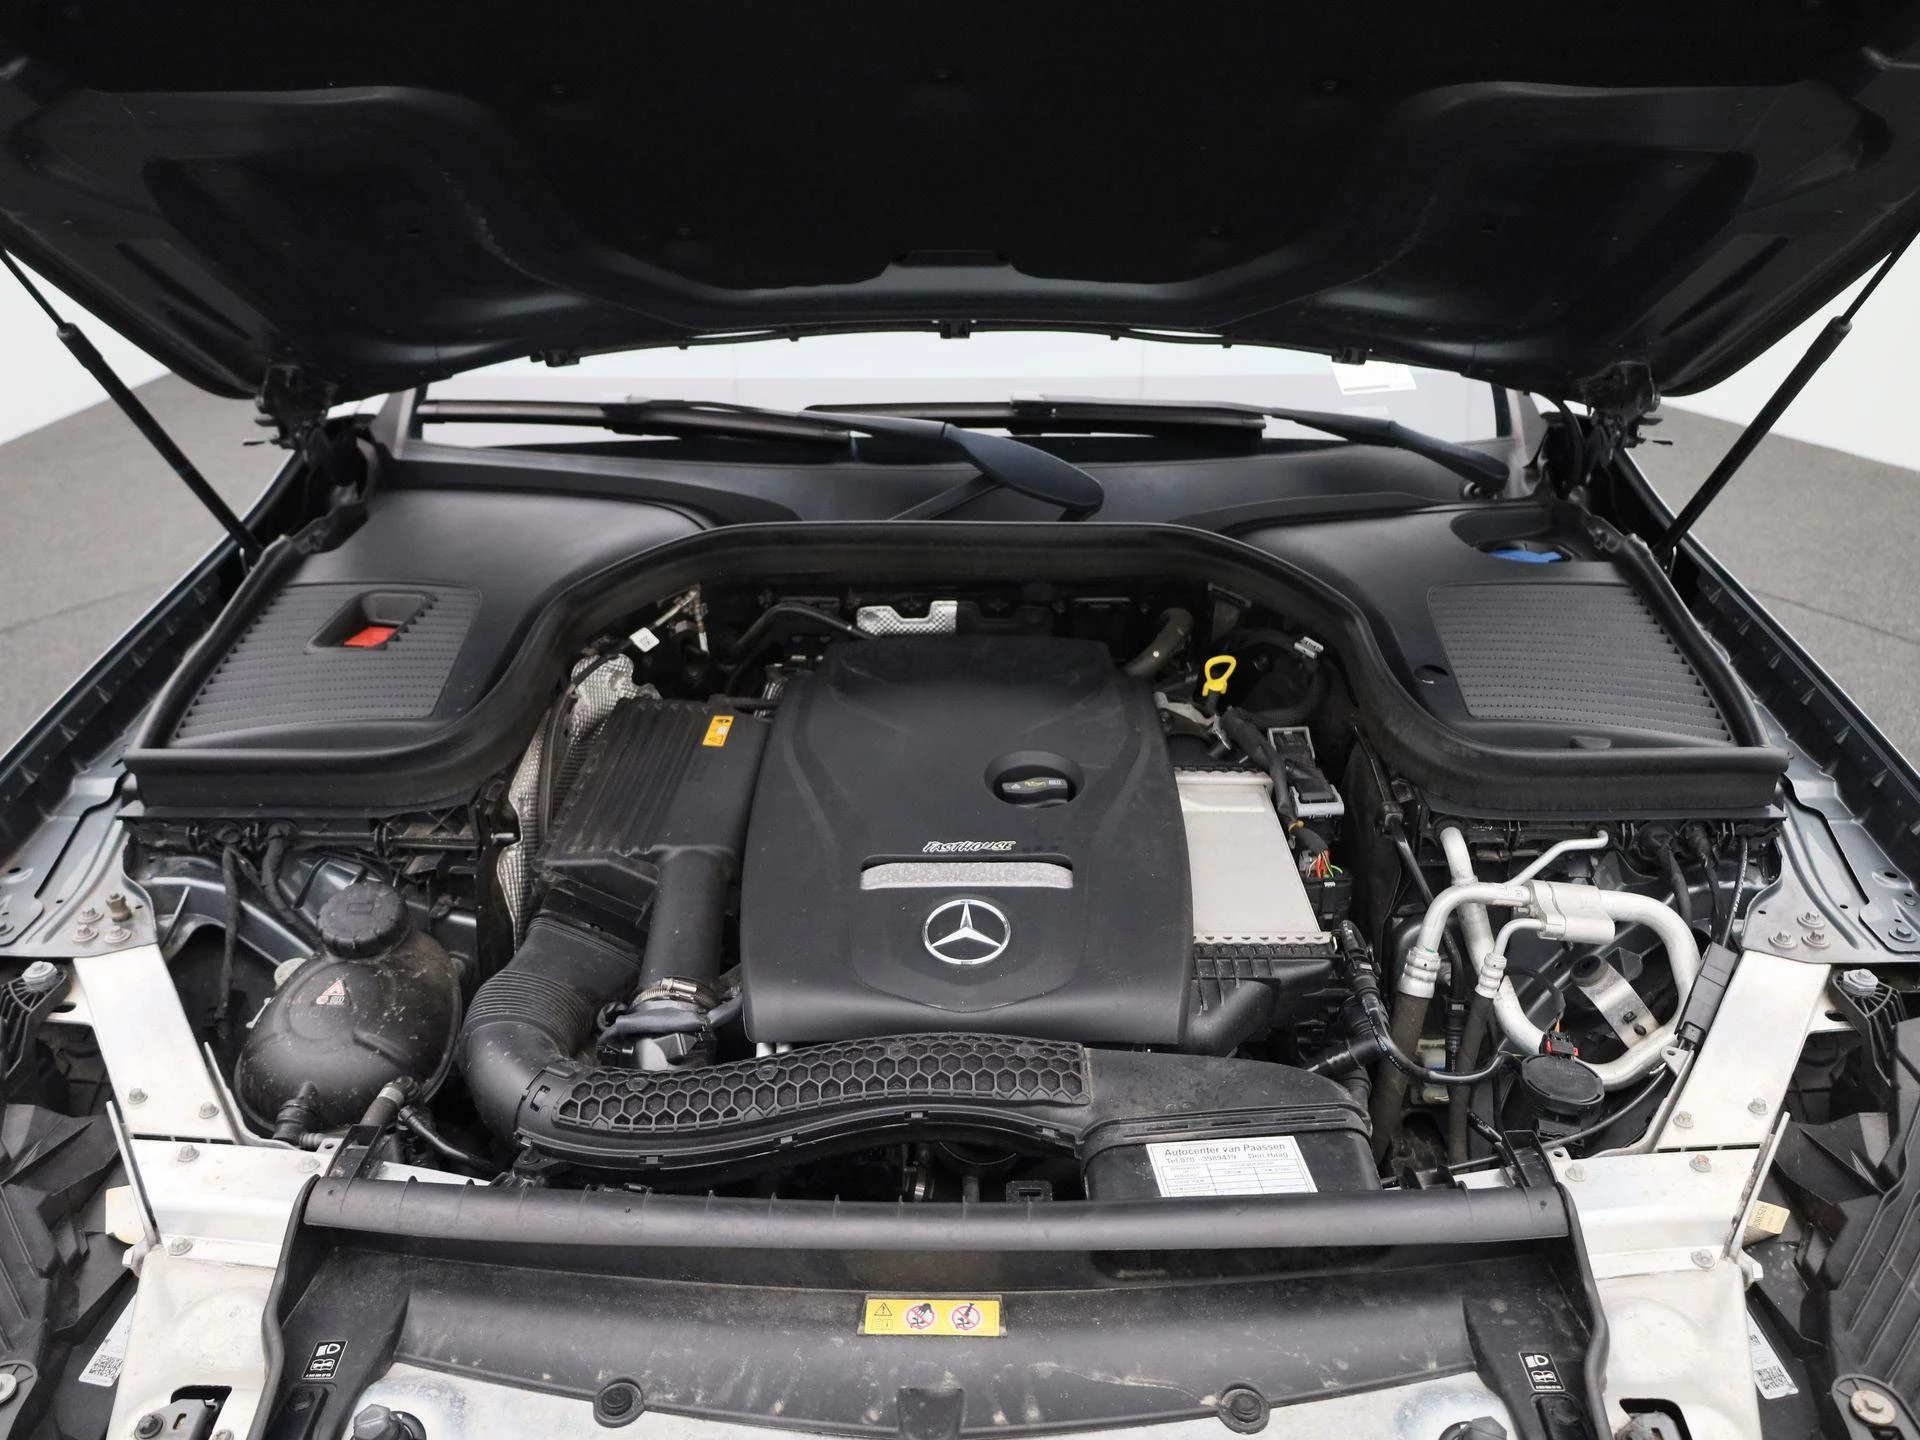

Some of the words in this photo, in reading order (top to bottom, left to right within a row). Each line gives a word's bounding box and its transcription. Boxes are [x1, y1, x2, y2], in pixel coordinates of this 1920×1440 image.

[922, 840, 1017, 853] FASTHOUSE
[1164, 1146, 1219, 1157] Autocenter
[1222, 1145, 1241, 1153] van
[1243, 1143, 1286, 1152] Paassen
